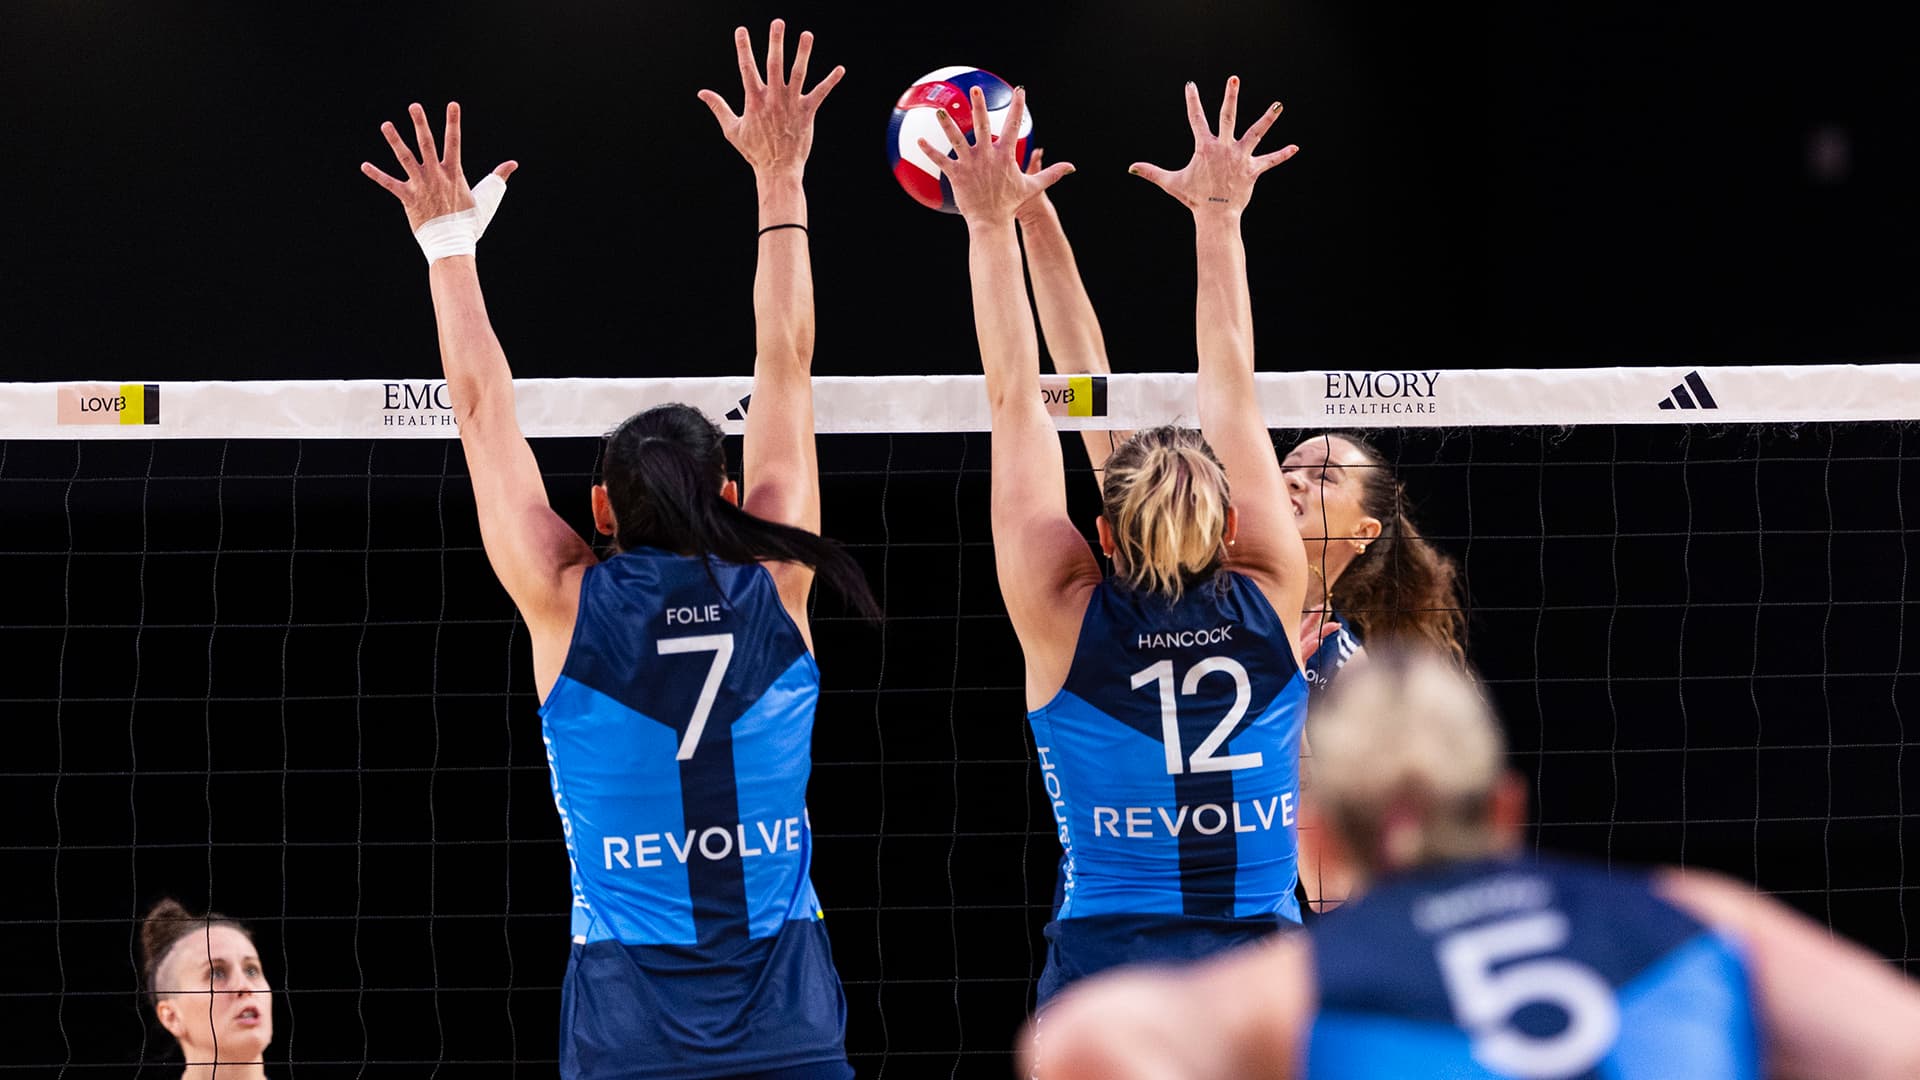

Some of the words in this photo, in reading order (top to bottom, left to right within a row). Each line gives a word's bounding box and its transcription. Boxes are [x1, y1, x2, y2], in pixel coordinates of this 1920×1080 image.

[383, 383, 453, 410] EMO
[1324, 372, 1440, 398] EMORY
[384, 415, 458, 426] HEALTH
[1326, 403, 1436, 414] HEALTHCARE
[666, 605, 720, 625] FOLIE
[1138, 625, 1232, 649] HANCOCK
[656, 633, 735, 761] 7
[1130, 656, 1264, 775] 12
[1094, 792, 1294, 838] REVOLVE
[603, 817, 800, 870] REVOLVE
[1435, 908, 1620, 1080] 5
